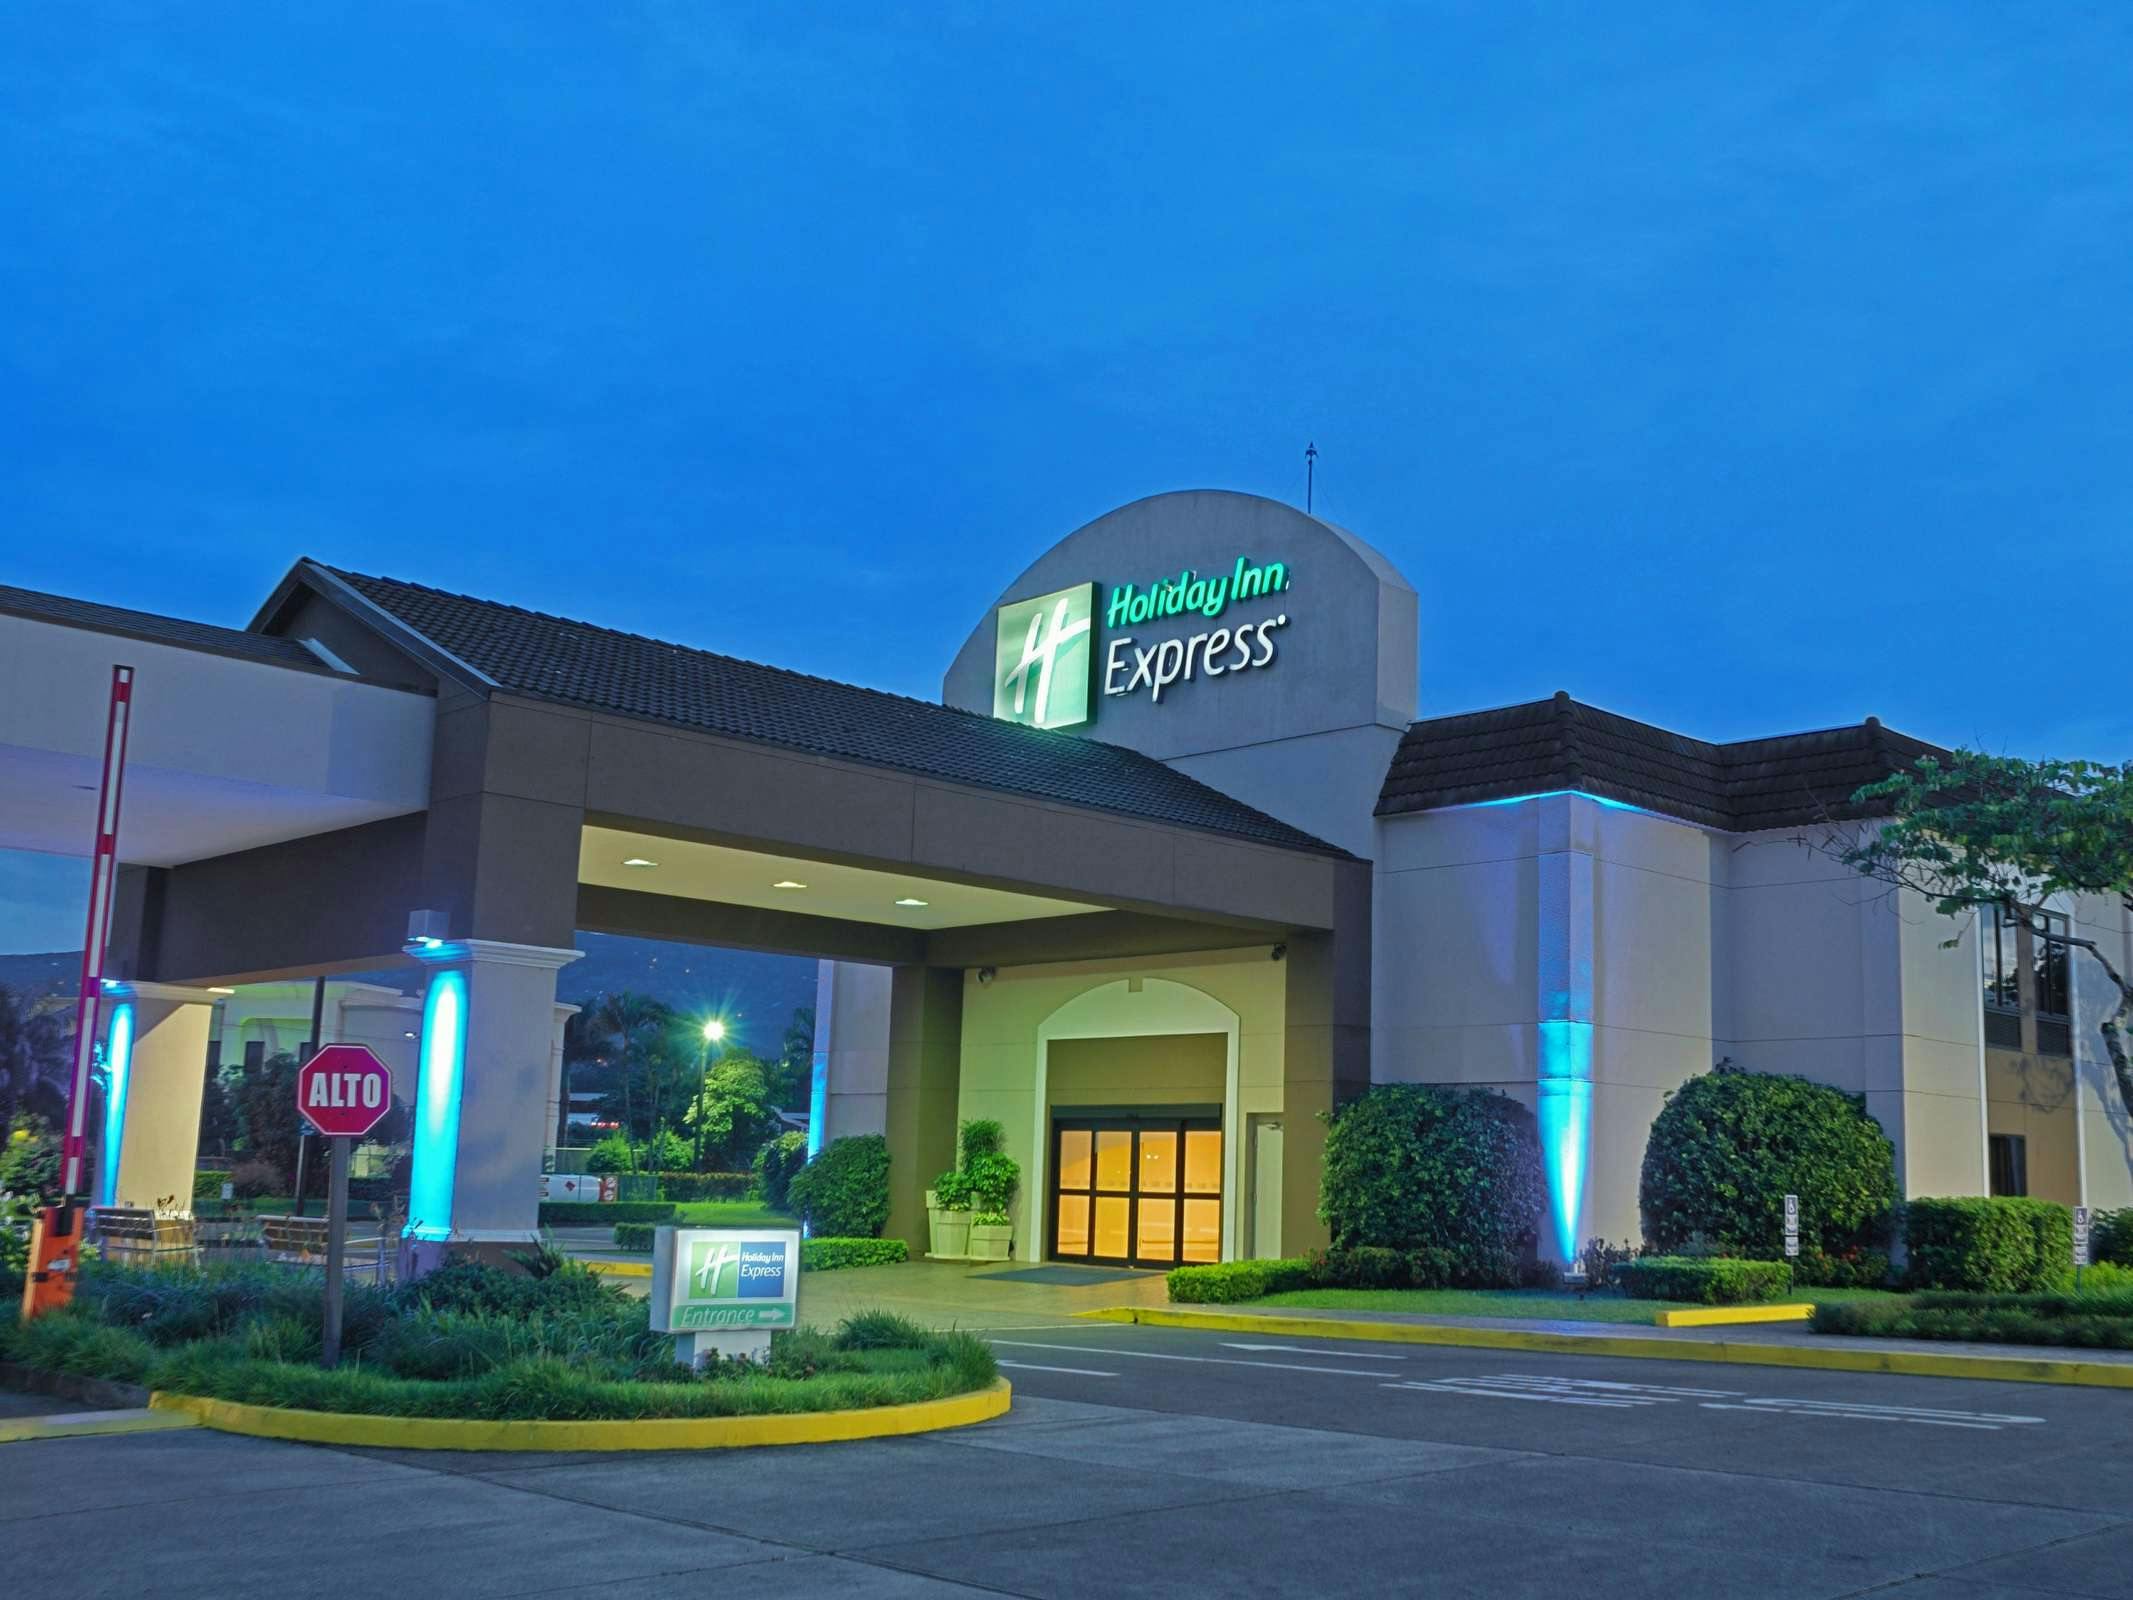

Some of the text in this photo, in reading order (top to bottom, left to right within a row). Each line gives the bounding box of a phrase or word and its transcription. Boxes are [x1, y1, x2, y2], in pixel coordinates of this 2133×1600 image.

[1107, 556, 1286, 628] Holiday Inn
[1104, 618, 1276, 702] Express
[308, 1072, 381, 1108] ALTO
[741, 1253, 771, 1264] Holiday
[741, 1265, 781, 1280] Express
[680, 1307, 755, 1328] Entrance
